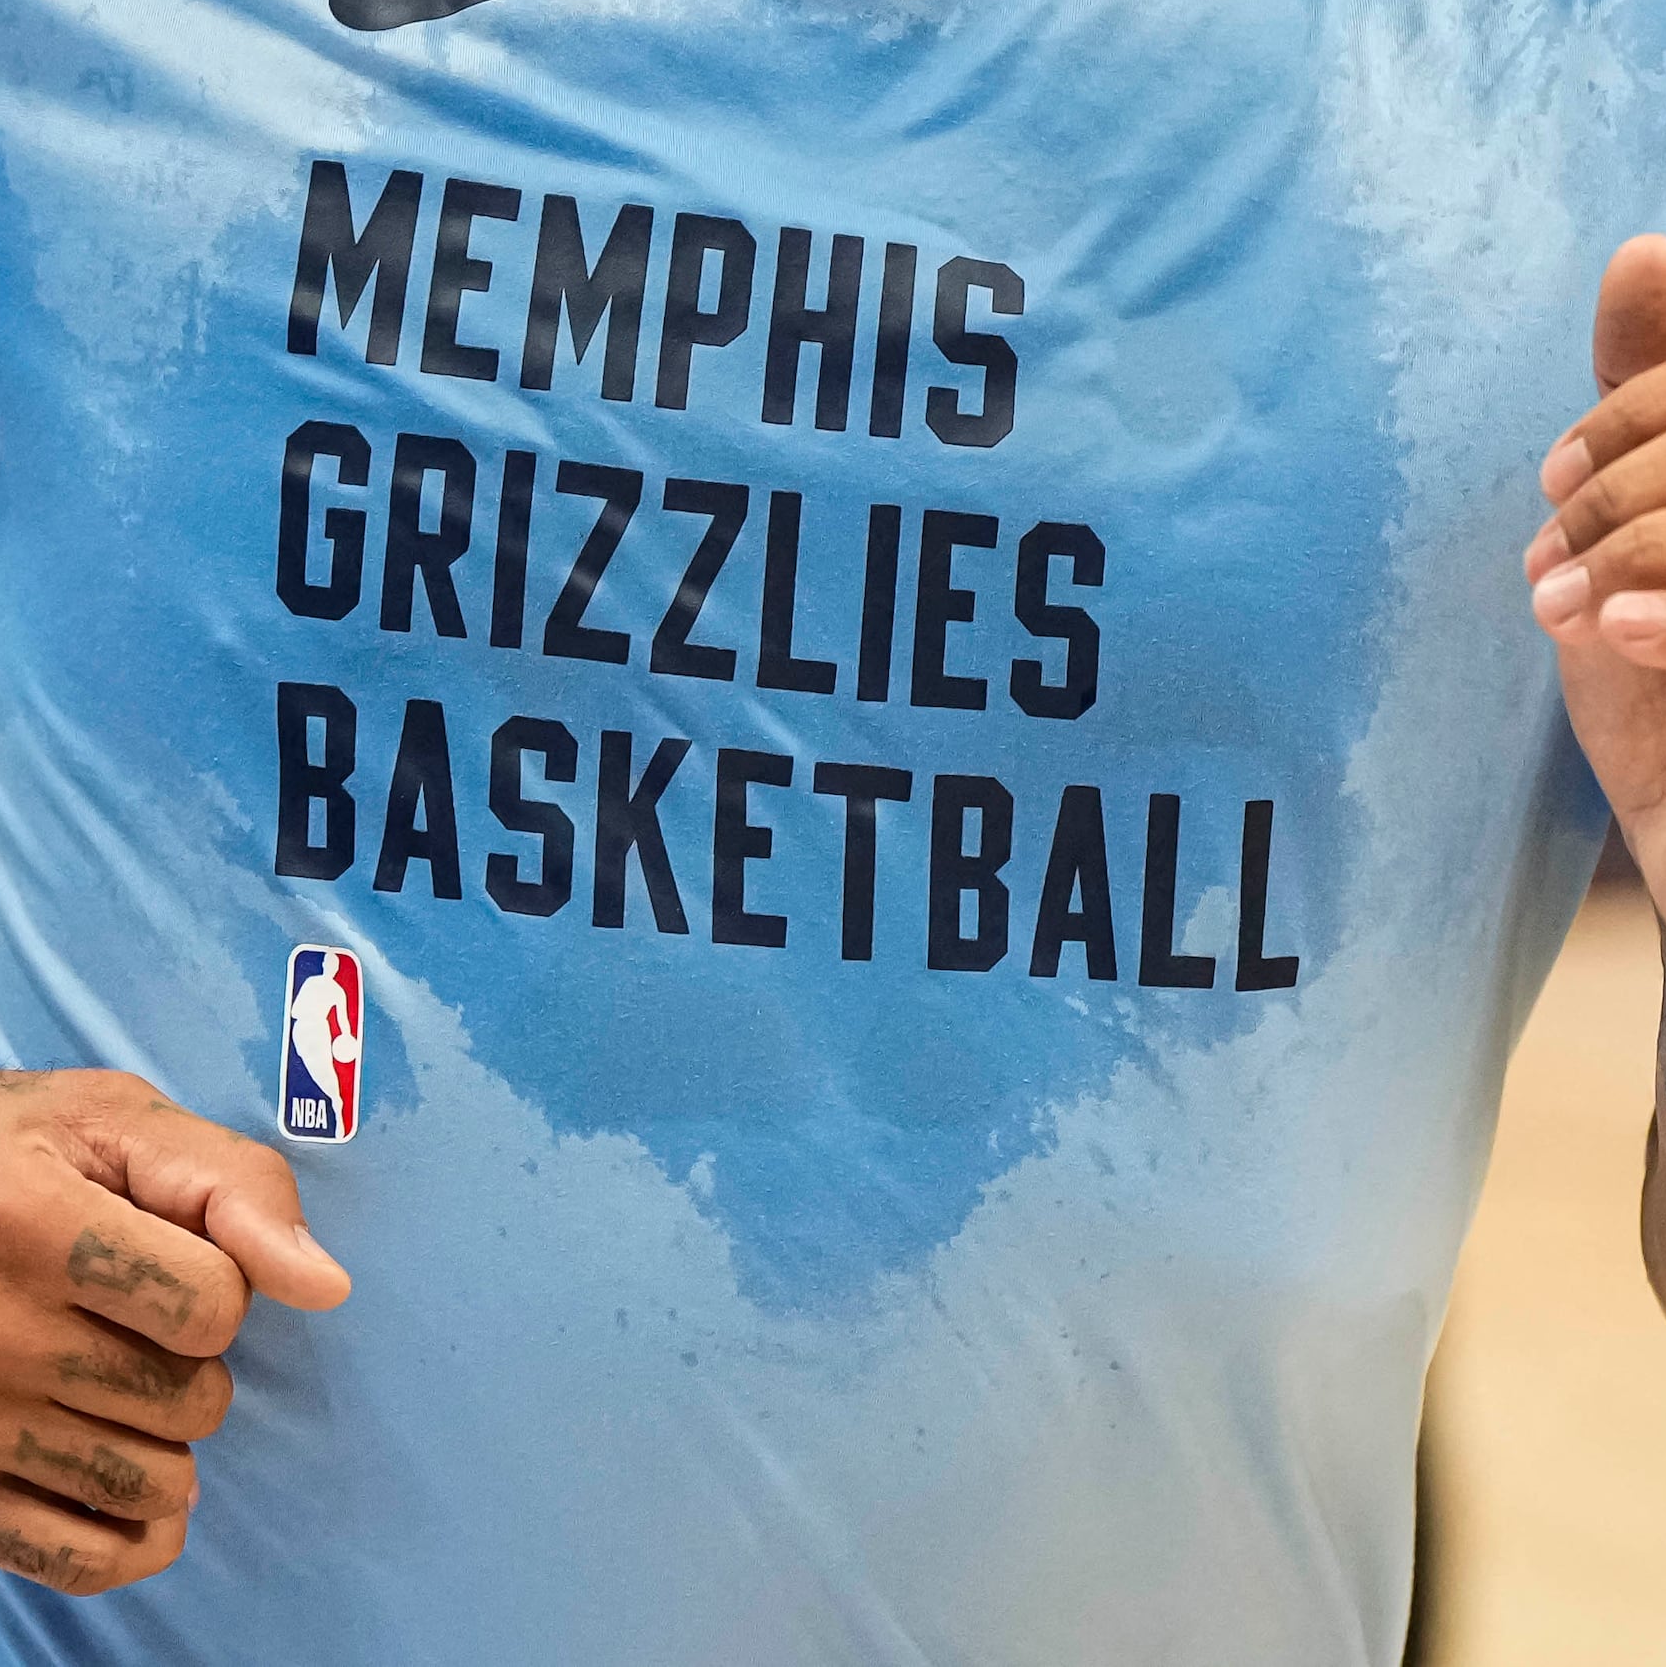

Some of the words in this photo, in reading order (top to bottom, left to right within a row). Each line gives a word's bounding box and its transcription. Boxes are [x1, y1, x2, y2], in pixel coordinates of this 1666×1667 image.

[285, 160, 1025, 449] MEMPHIS
[274, 419, 1107, 721] GRIZZLIES
[273, 680, 1301, 992] BASKETBALL
[290, 1096, 328, 1130] NBA
